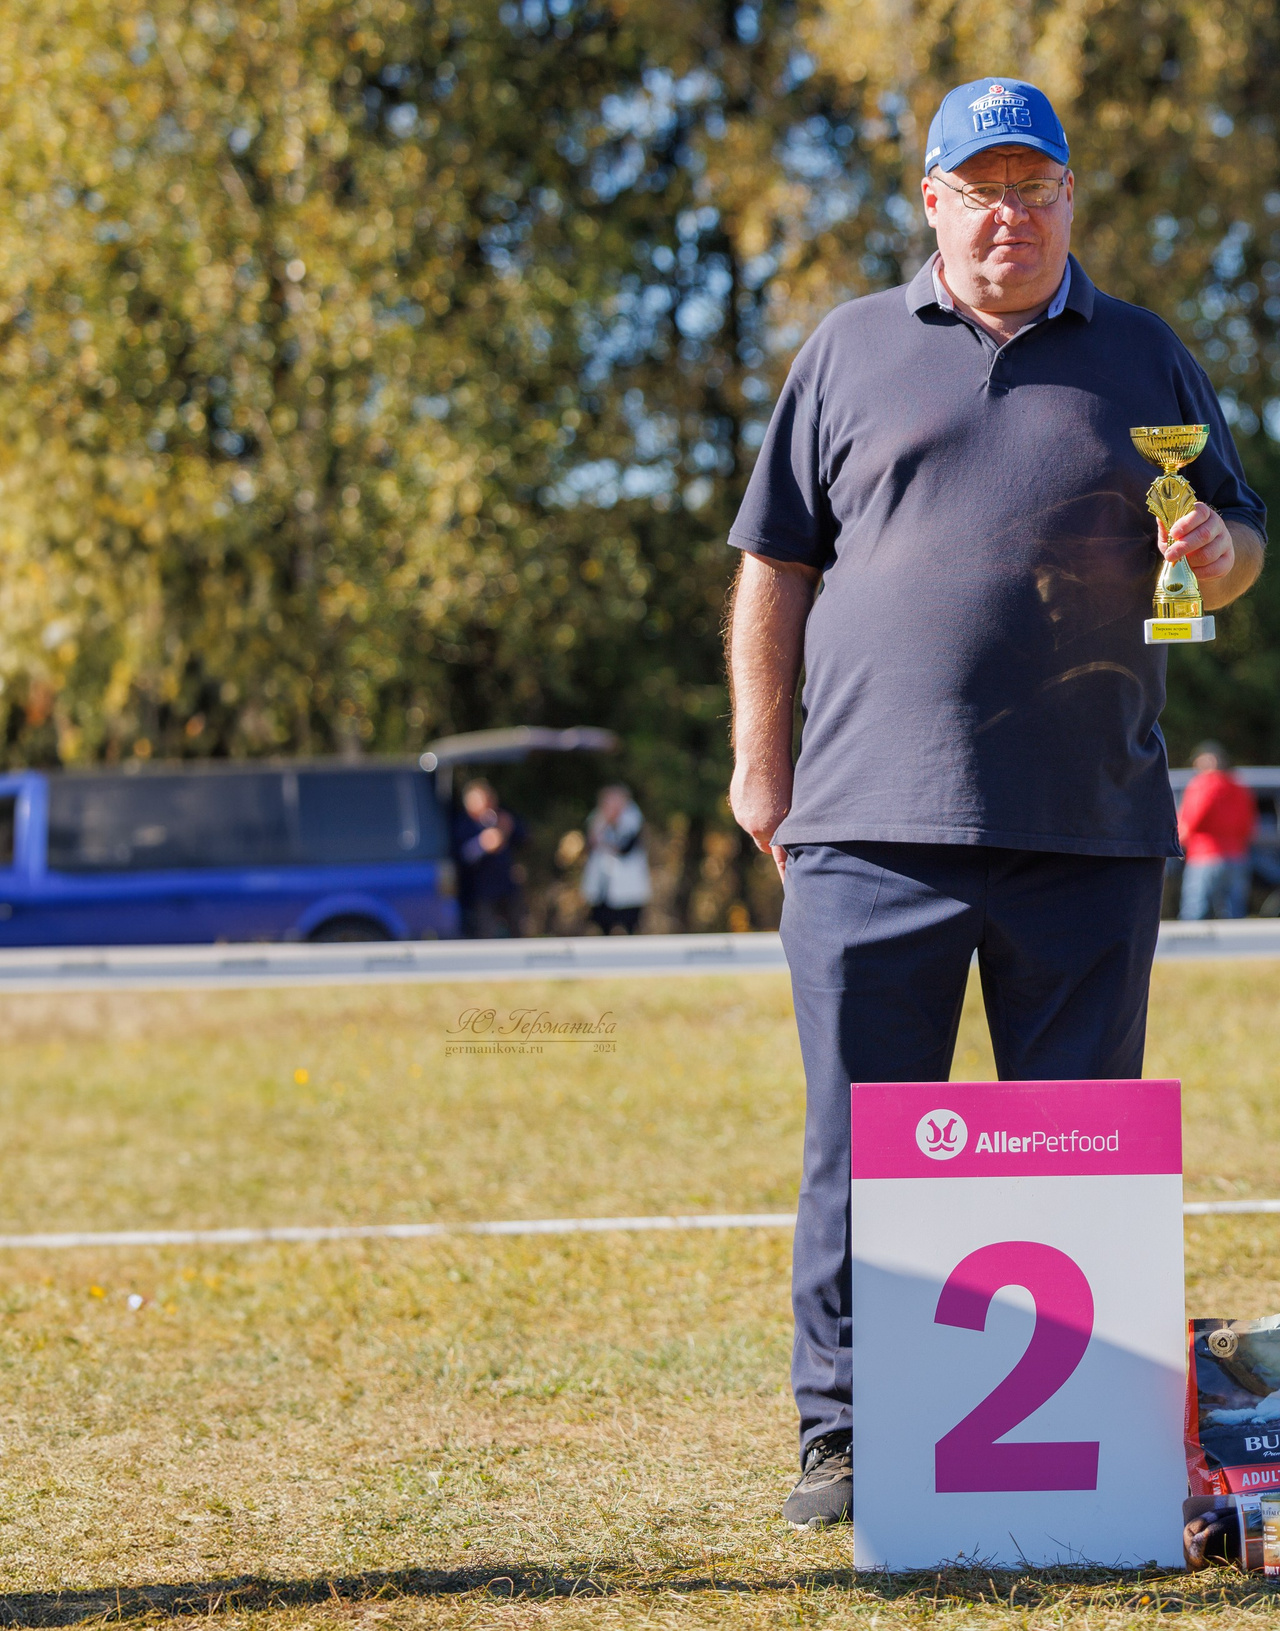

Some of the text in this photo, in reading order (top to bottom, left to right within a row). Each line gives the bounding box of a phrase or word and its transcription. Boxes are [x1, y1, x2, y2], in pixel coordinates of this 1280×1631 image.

[973, 107, 1032, 132] 1946
[975, 1129, 1119, 1154] AllerPetfood
[932, 1239, 1099, 1493] 2
